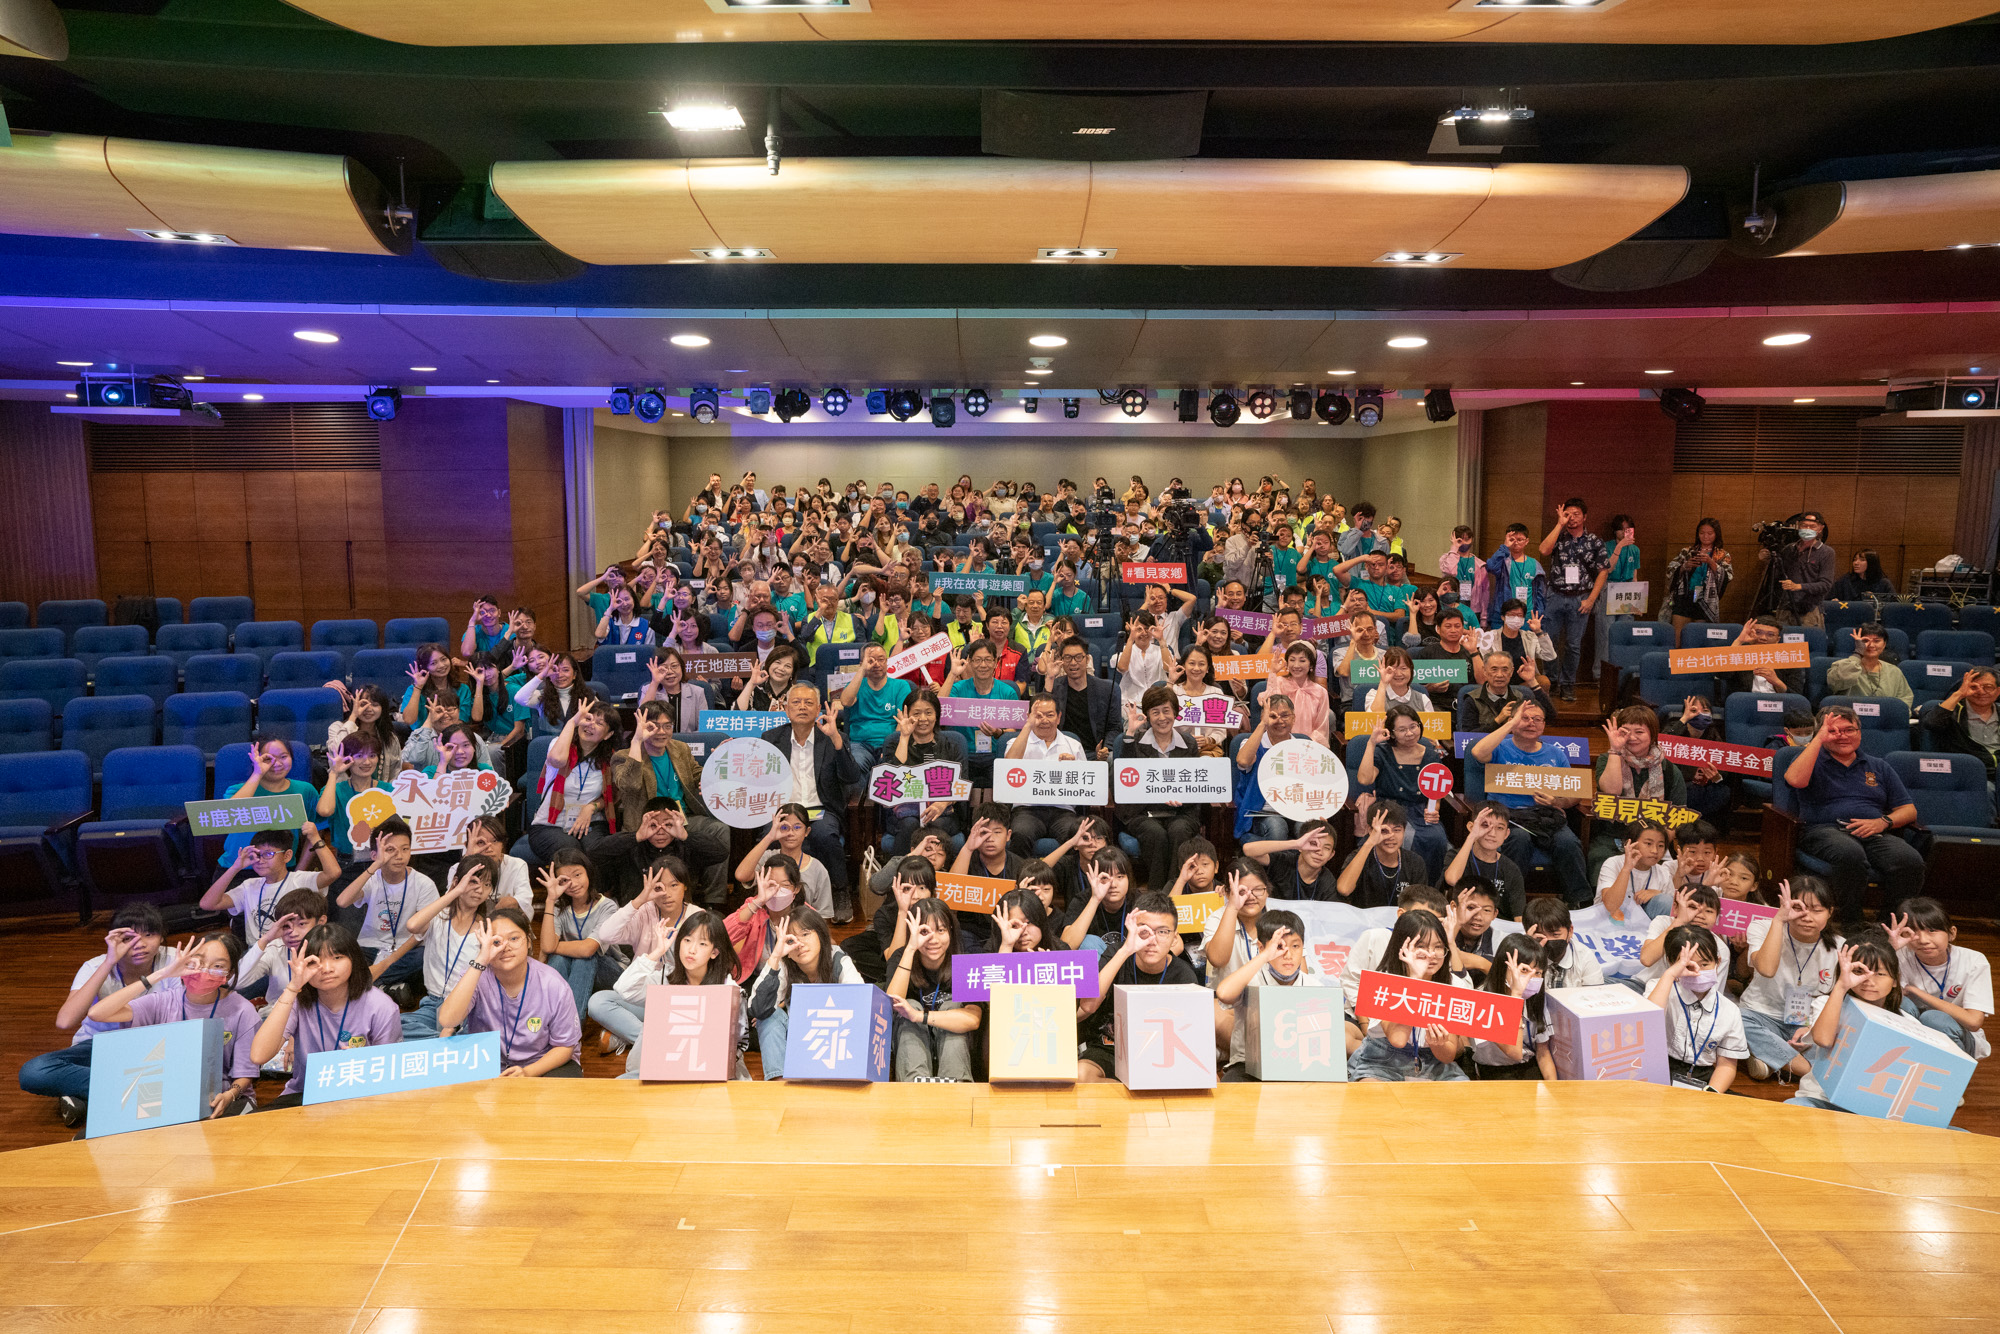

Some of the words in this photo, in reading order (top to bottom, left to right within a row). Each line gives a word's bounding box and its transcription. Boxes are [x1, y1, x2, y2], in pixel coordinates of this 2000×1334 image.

[935, 578, 1025, 592] #我在故事遊樂園
[1127, 567, 1183, 579] #看見家鄉
[1677, 650, 1806, 668] #台北市華朋扶輪社
[706, 716, 791, 731] #空拍手非我
[940, 703, 1029, 722] 我一起探索家
[1176, 697, 1240, 726] 續豐年
[873, 765, 968, 802] 永續豐年
[1032, 770, 1096, 785] 永豐銀行
[1146, 768, 1209, 783] 永豐金控
[1495, 772, 1581, 791] #監製導師
[709, 787, 787, 817] 永續豐年
[1032, 788, 1056, 796] Bank
[1058, 788, 1096, 797] SinoPac
[1145, 785, 1183, 794] SinoPac
[1185, 785, 1227, 794] Holdings
[1265, 783, 1343, 811] 永續豐年
[198, 804, 293, 828] #鹿港國小
[1594, 794, 1700, 830] 看見家鄉
[966, 961, 1084, 990] #壽山國中
[1373, 985, 1505, 1029] #大社國小
[802, 994, 855, 1070] 家
[1135, 1007, 1211, 1075] 永
[317, 1044, 491, 1089] #東引國中小
[1857, 1045, 1951, 1122] 年
